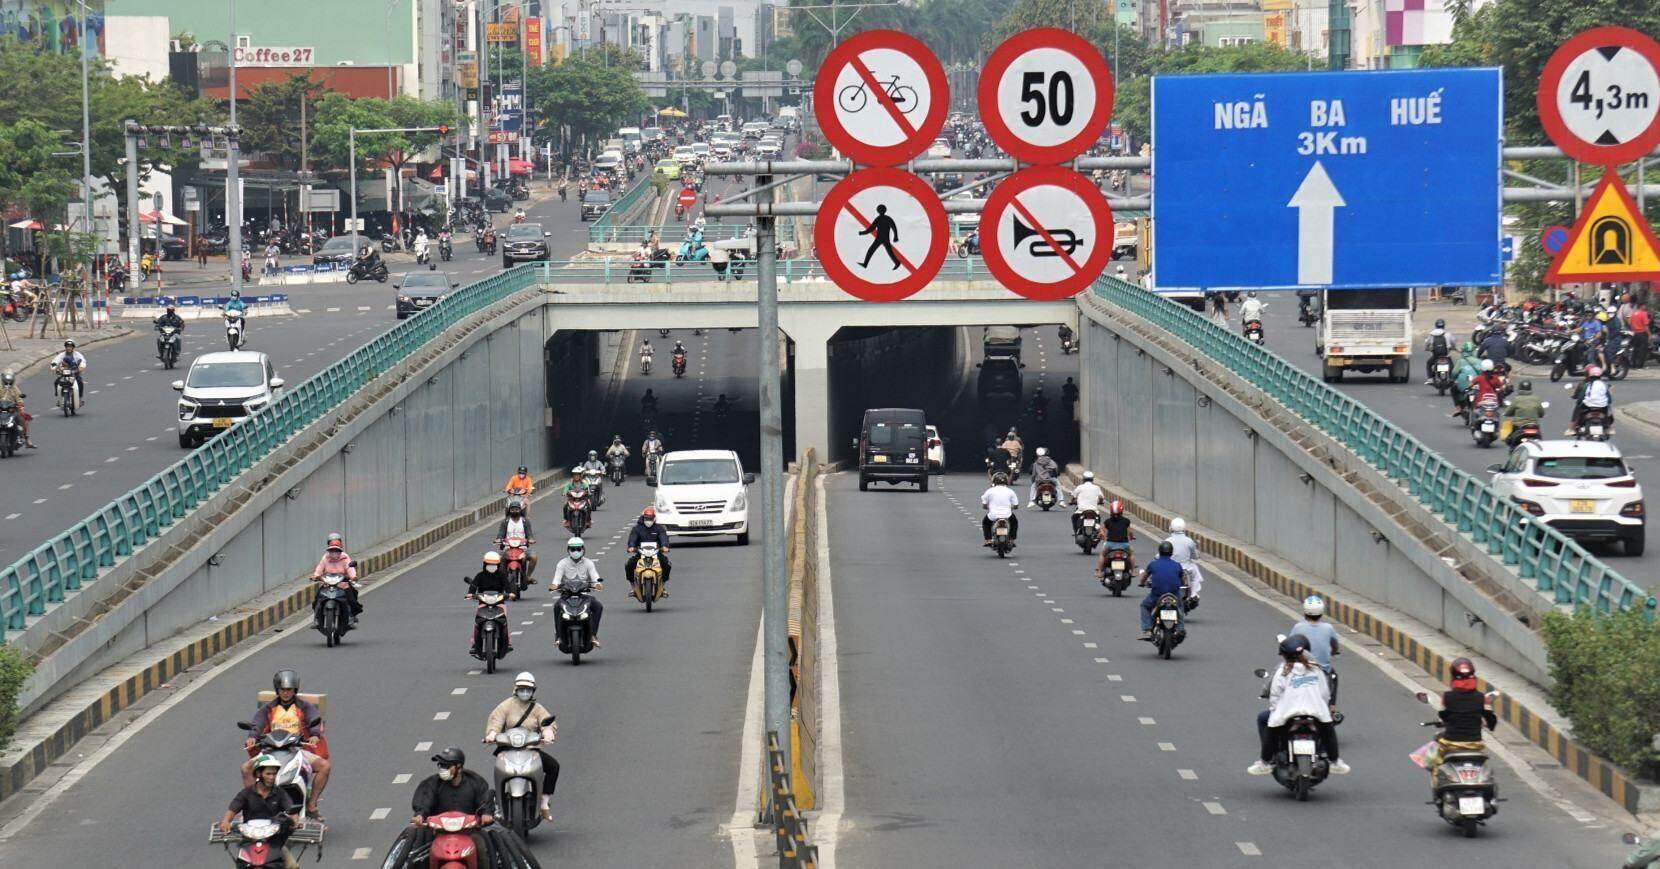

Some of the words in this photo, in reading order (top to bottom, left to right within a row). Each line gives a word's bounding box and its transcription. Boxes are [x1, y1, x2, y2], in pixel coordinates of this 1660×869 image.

[233, 48, 290, 62] Coffee
[293, 48, 312, 62] 27
[1020, 70, 1075, 127] 50
[1214, 93, 1268, 129] NGÃ
[1310, 99, 1346, 127] BA
[1390, 87, 1445, 126] HUẾ
[1570, 70, 1648, 120] 4,3m
[1297, 131, 1367, 155] 3Km
